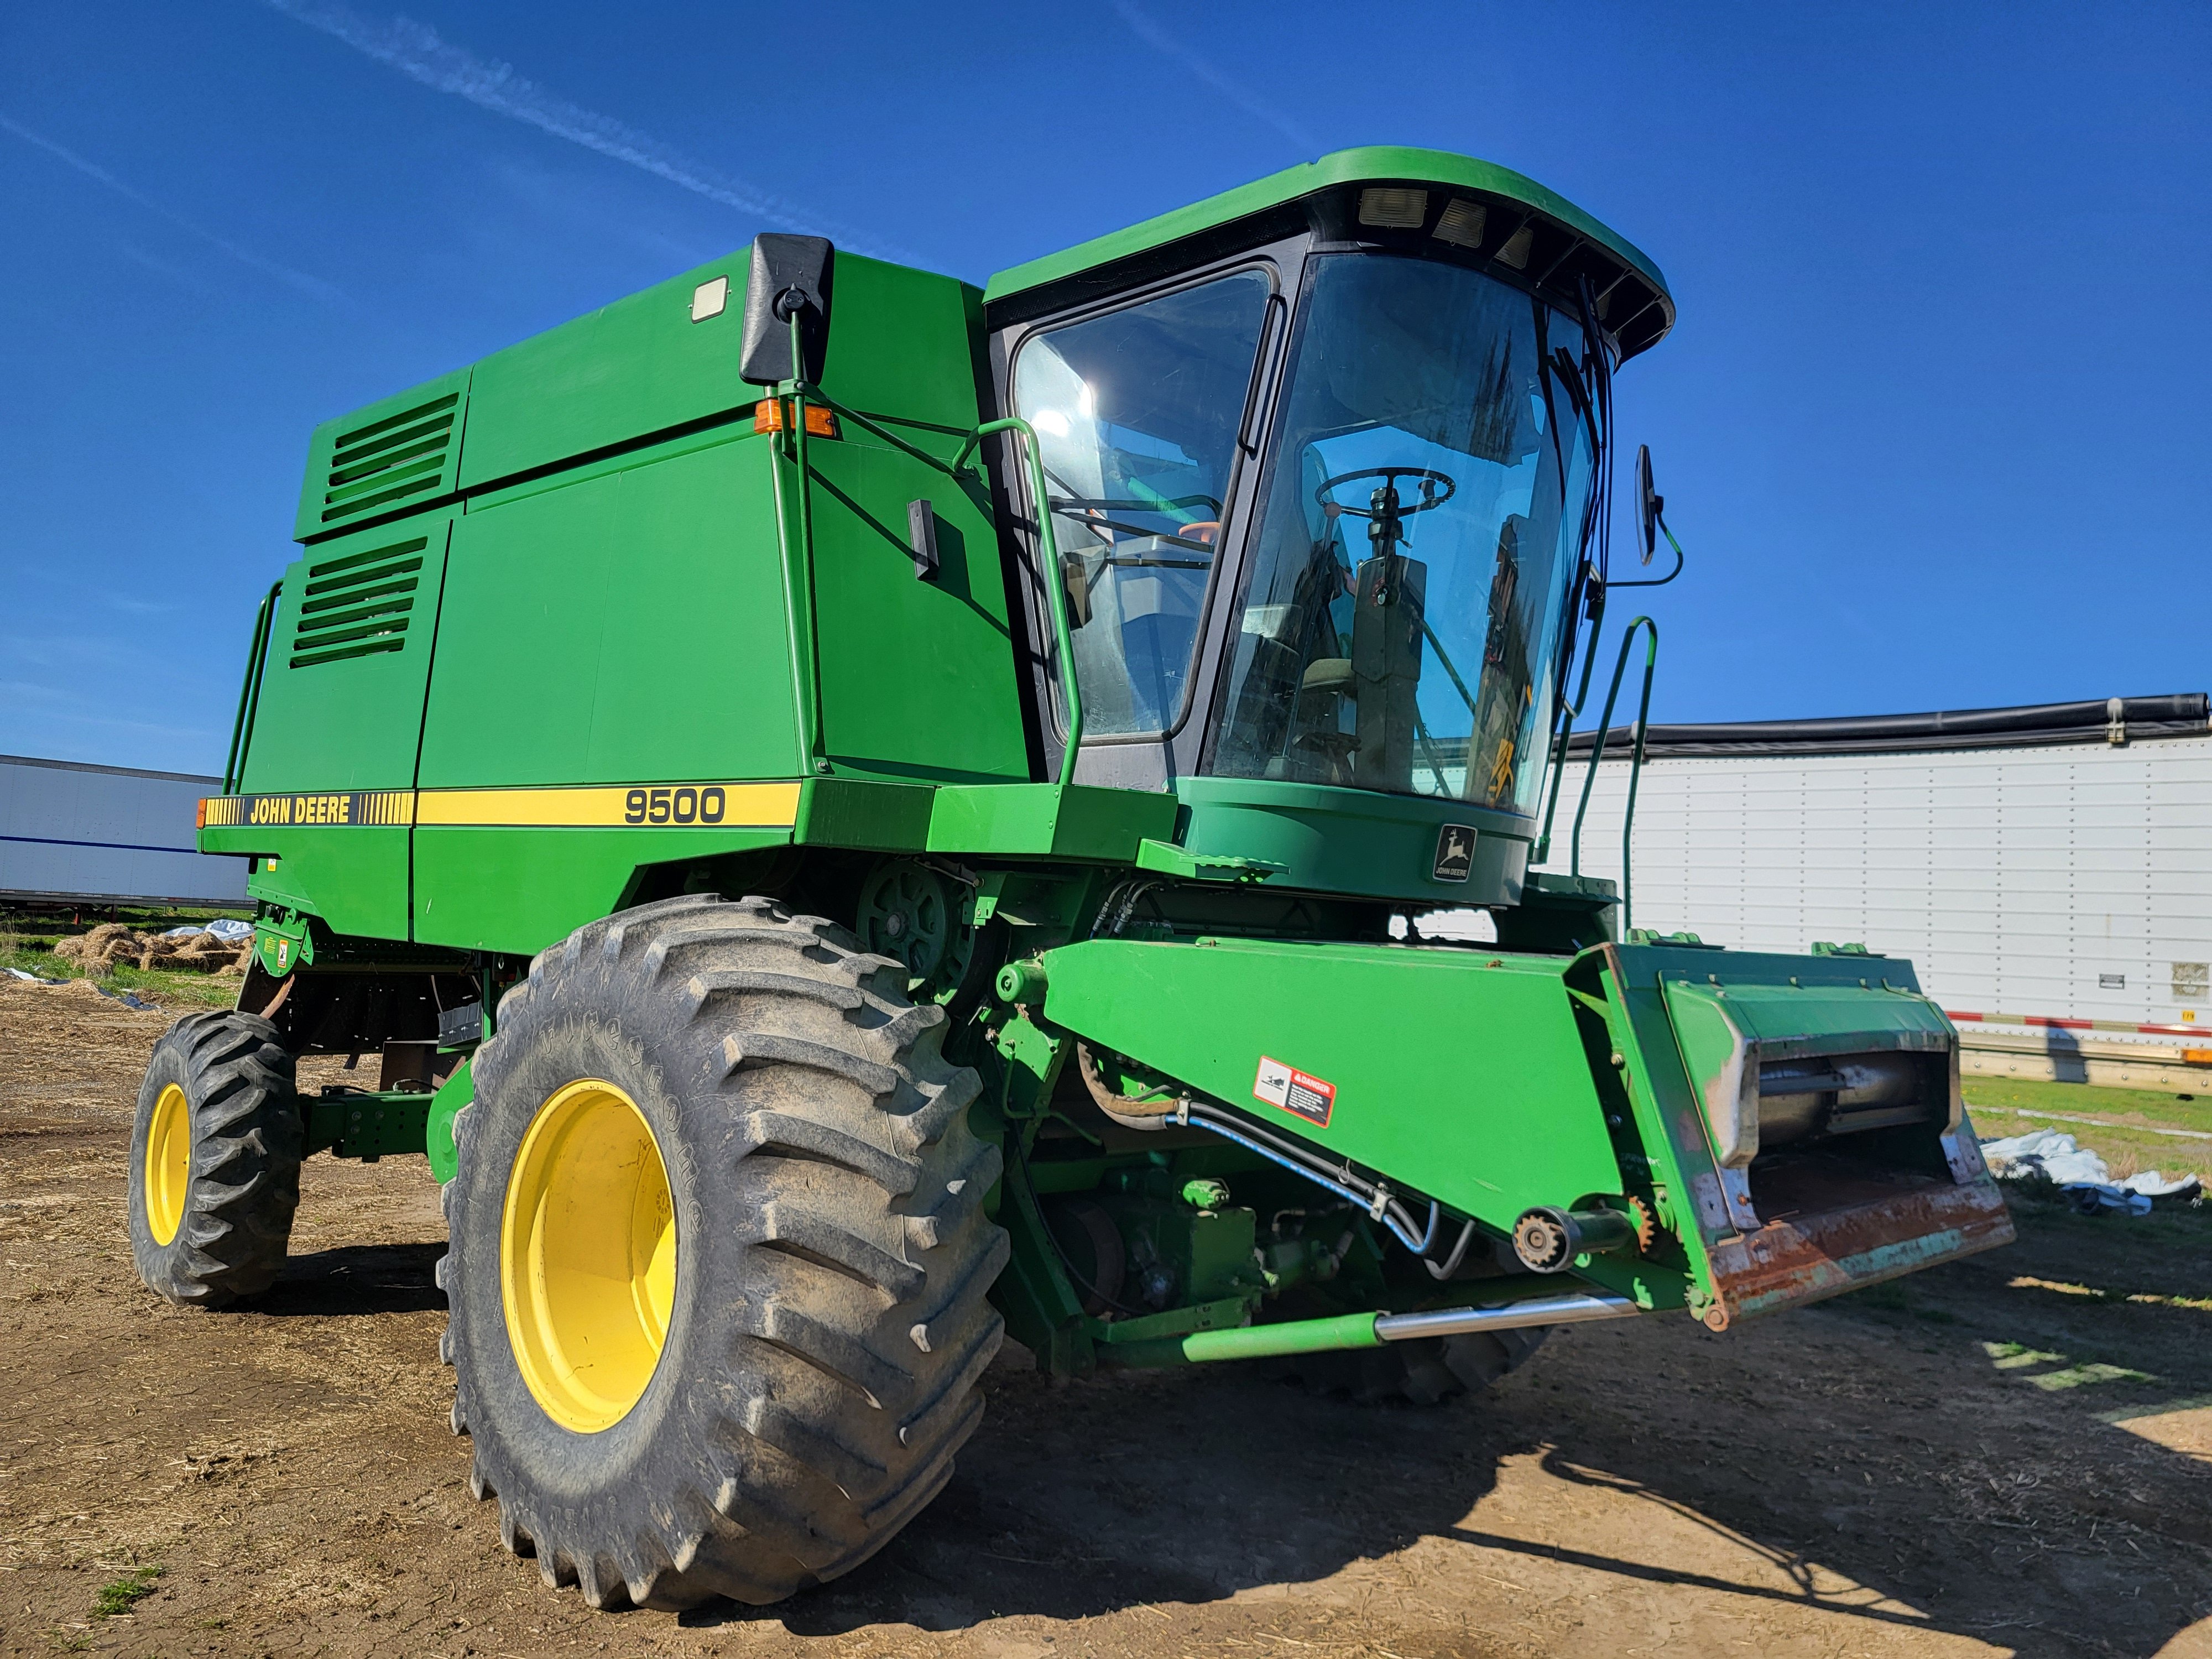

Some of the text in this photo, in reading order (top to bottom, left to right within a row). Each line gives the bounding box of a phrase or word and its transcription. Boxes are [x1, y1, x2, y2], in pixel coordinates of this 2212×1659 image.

[251, 796, 351, 824] JOHN DEERE
[625, 787, 726, 824] 9500
[1450, 868, 1467, 877] DEERE
[1301, 1076, 1331, 1095] DANGER
